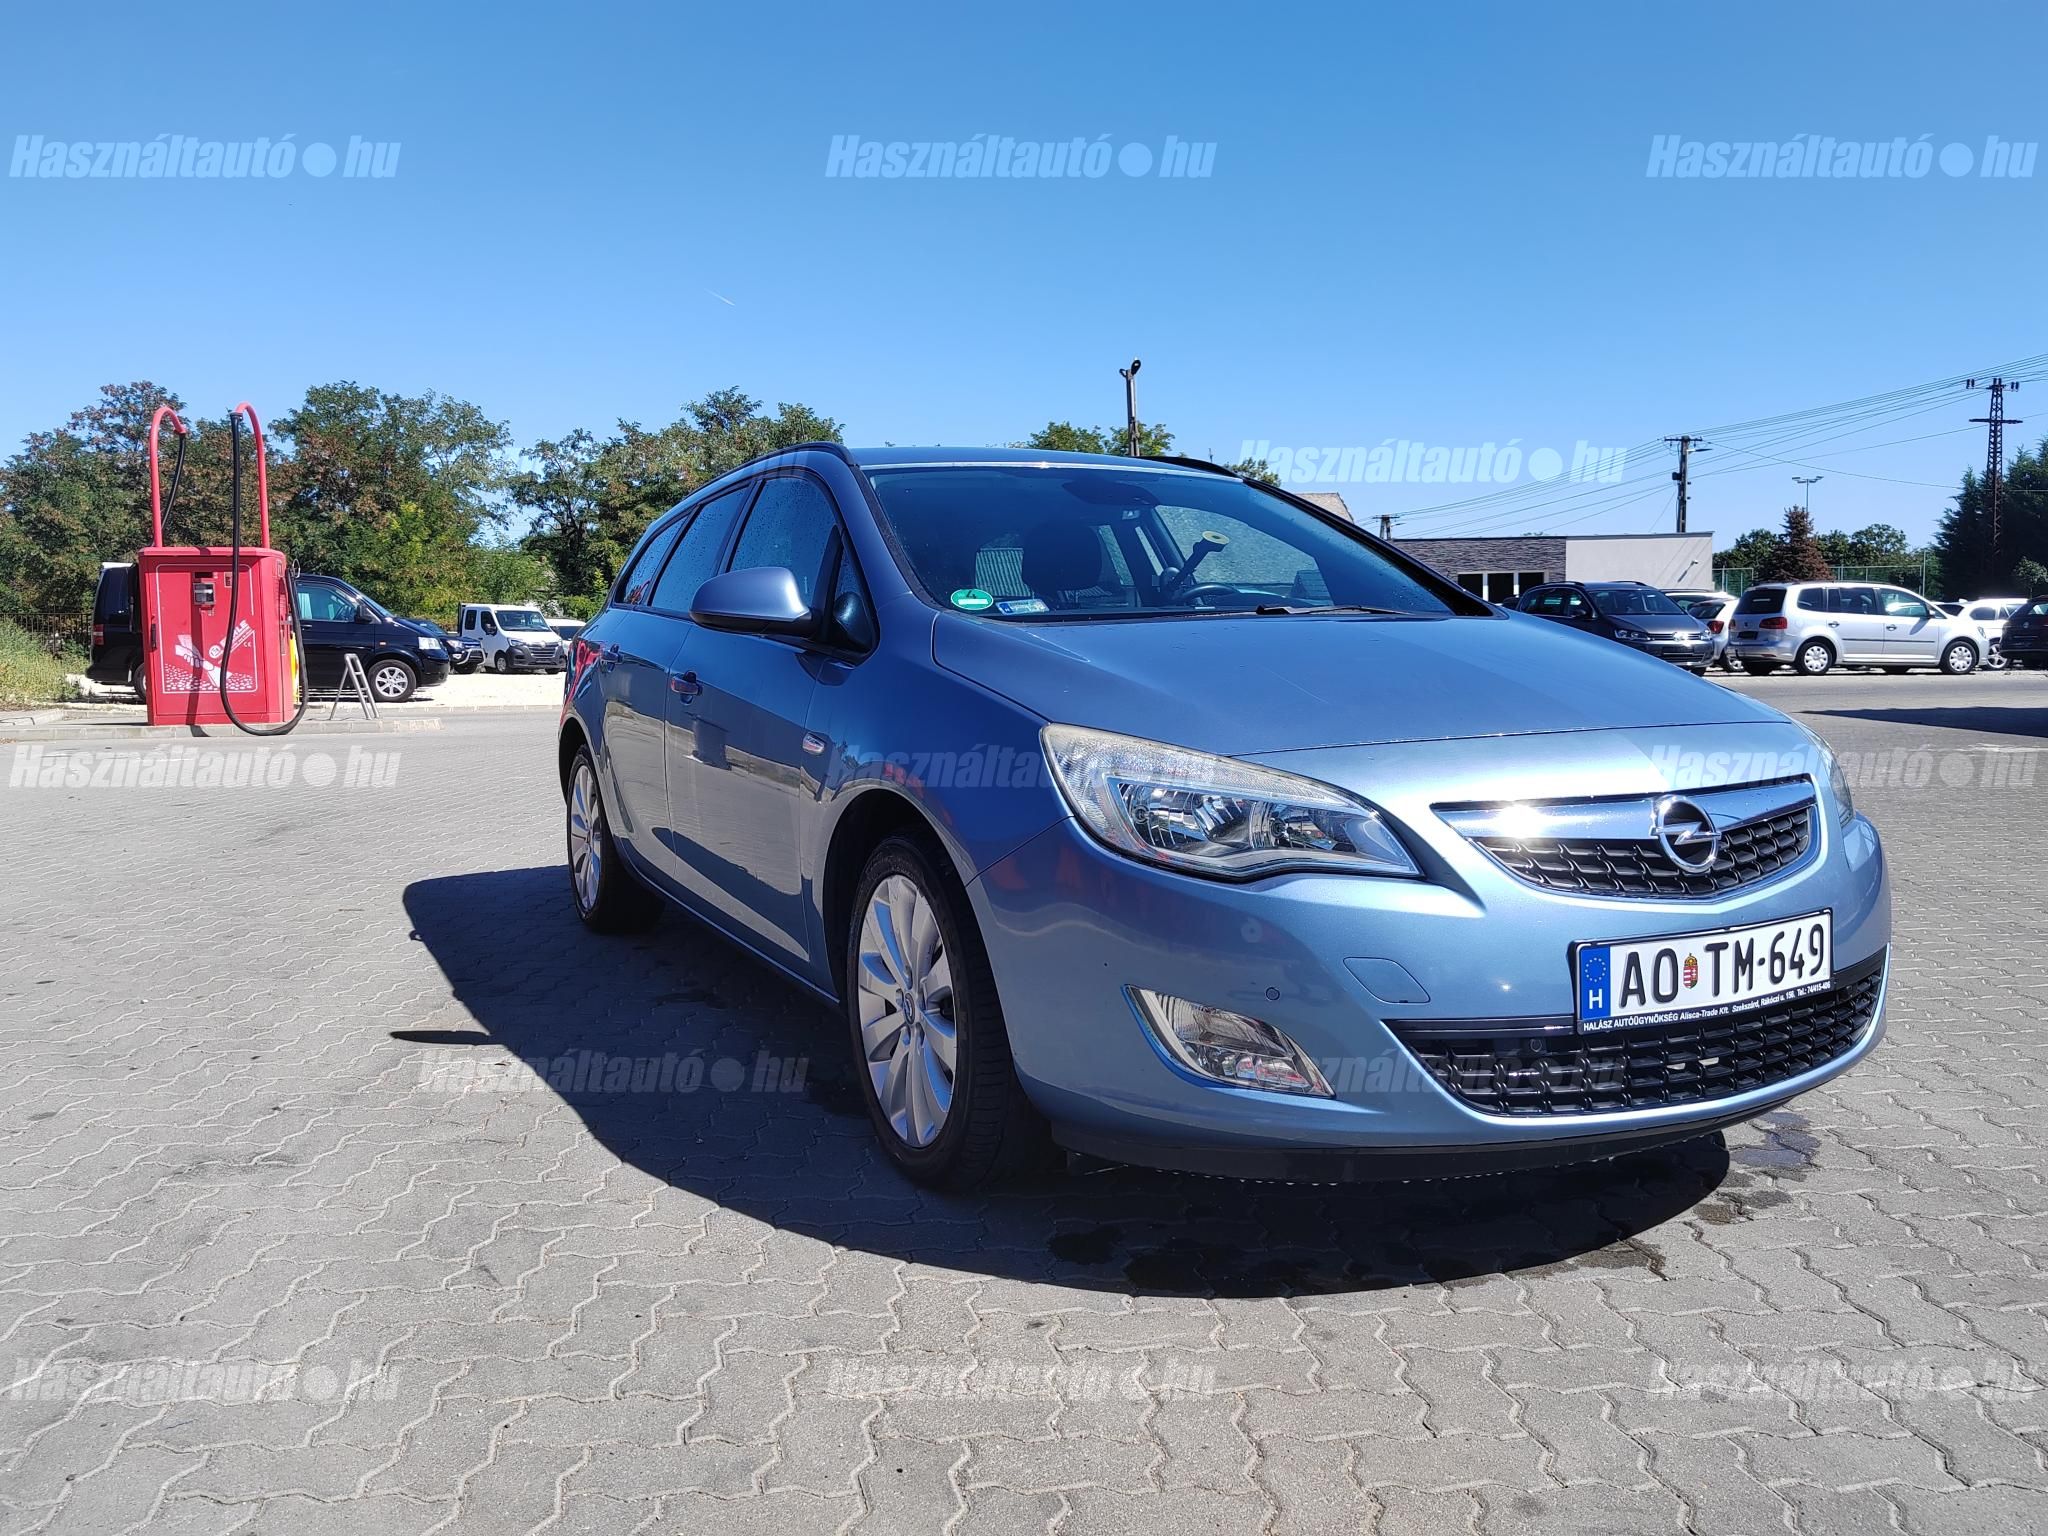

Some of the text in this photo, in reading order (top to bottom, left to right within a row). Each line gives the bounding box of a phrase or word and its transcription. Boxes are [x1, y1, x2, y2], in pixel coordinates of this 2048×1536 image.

[1619, 923, 1825, 1008] AO TM-649
[1588, 988, 1603, 1010] H
[1583, 1020, 1612, 1031] HALÁSZ
